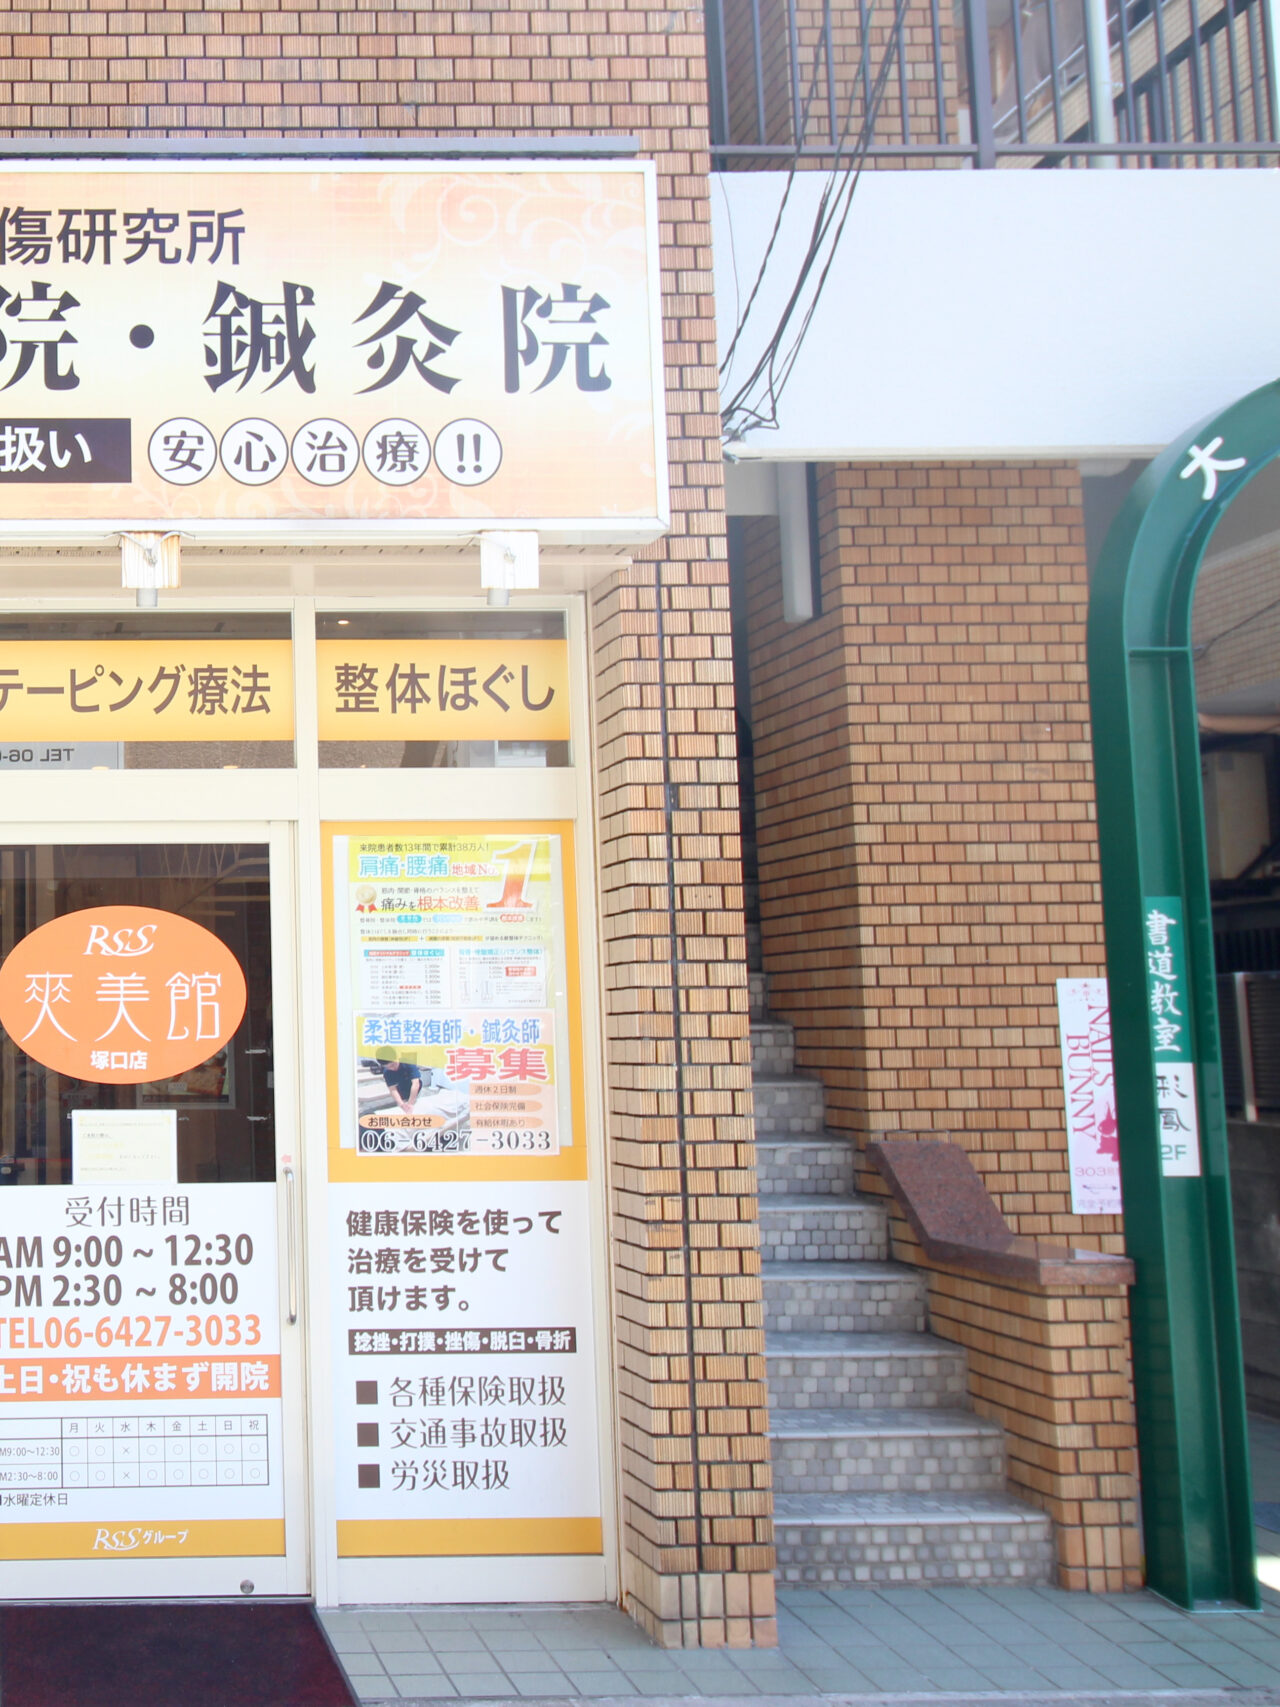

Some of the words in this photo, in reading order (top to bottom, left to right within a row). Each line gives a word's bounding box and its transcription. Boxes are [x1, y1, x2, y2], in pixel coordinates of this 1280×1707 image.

[334, 662, 556, 716] 整体ほぐし
[381, 896, 480, 911] 痛みを根本改善
[82, 924, 158, 957] RSS
[1145, 909, 1183, 1052] 書道教室
[363, 1018, 541, 1045] 柔道整復師・鍼灸師
[90, 1050, 148, 1070] 塚口店
[446, 1048, 548, 1081] 募集
[1066, 1033, 1097, 1140] BUNNY
[367, 1117, 433, 1129] お問い合わせ
[361, 1130, 551, 1153] 06-6427-3033
[65, 1195, 190, 1228] 受付時間
[346, 1208, 563, 1237] 健康保険を使って
[52, 1235, 123, 1268] 9:00
[164, 1233, 254, 1267] 12:30
[347, 1247, 509, 1275] 治療を受けて
[52, 1273, 122, 1307] 2:30
[168, 1272, 239, 1305] 8:00
[348, 1285, 470, 1312] 頂けます。
[388, 1374, 566, 1407] 各種保険取扱
[69, 1423, 80, 1434] 月
[94, 1422, 106, 1433] 火
[120, 1422, 131, 1433] 水
[146, 1421, 157, 1433] 木
[171, 1421, 183, 1432] 金
[197, 1420, 209, 1432] 土
[223, 1420, 233, 1431] 日
[248, 1419, 260, 1431] 祝
[389, 1416, 568, 1449] 交通事故取扱
[391, 1458, 511, 1491] 労災取扱
